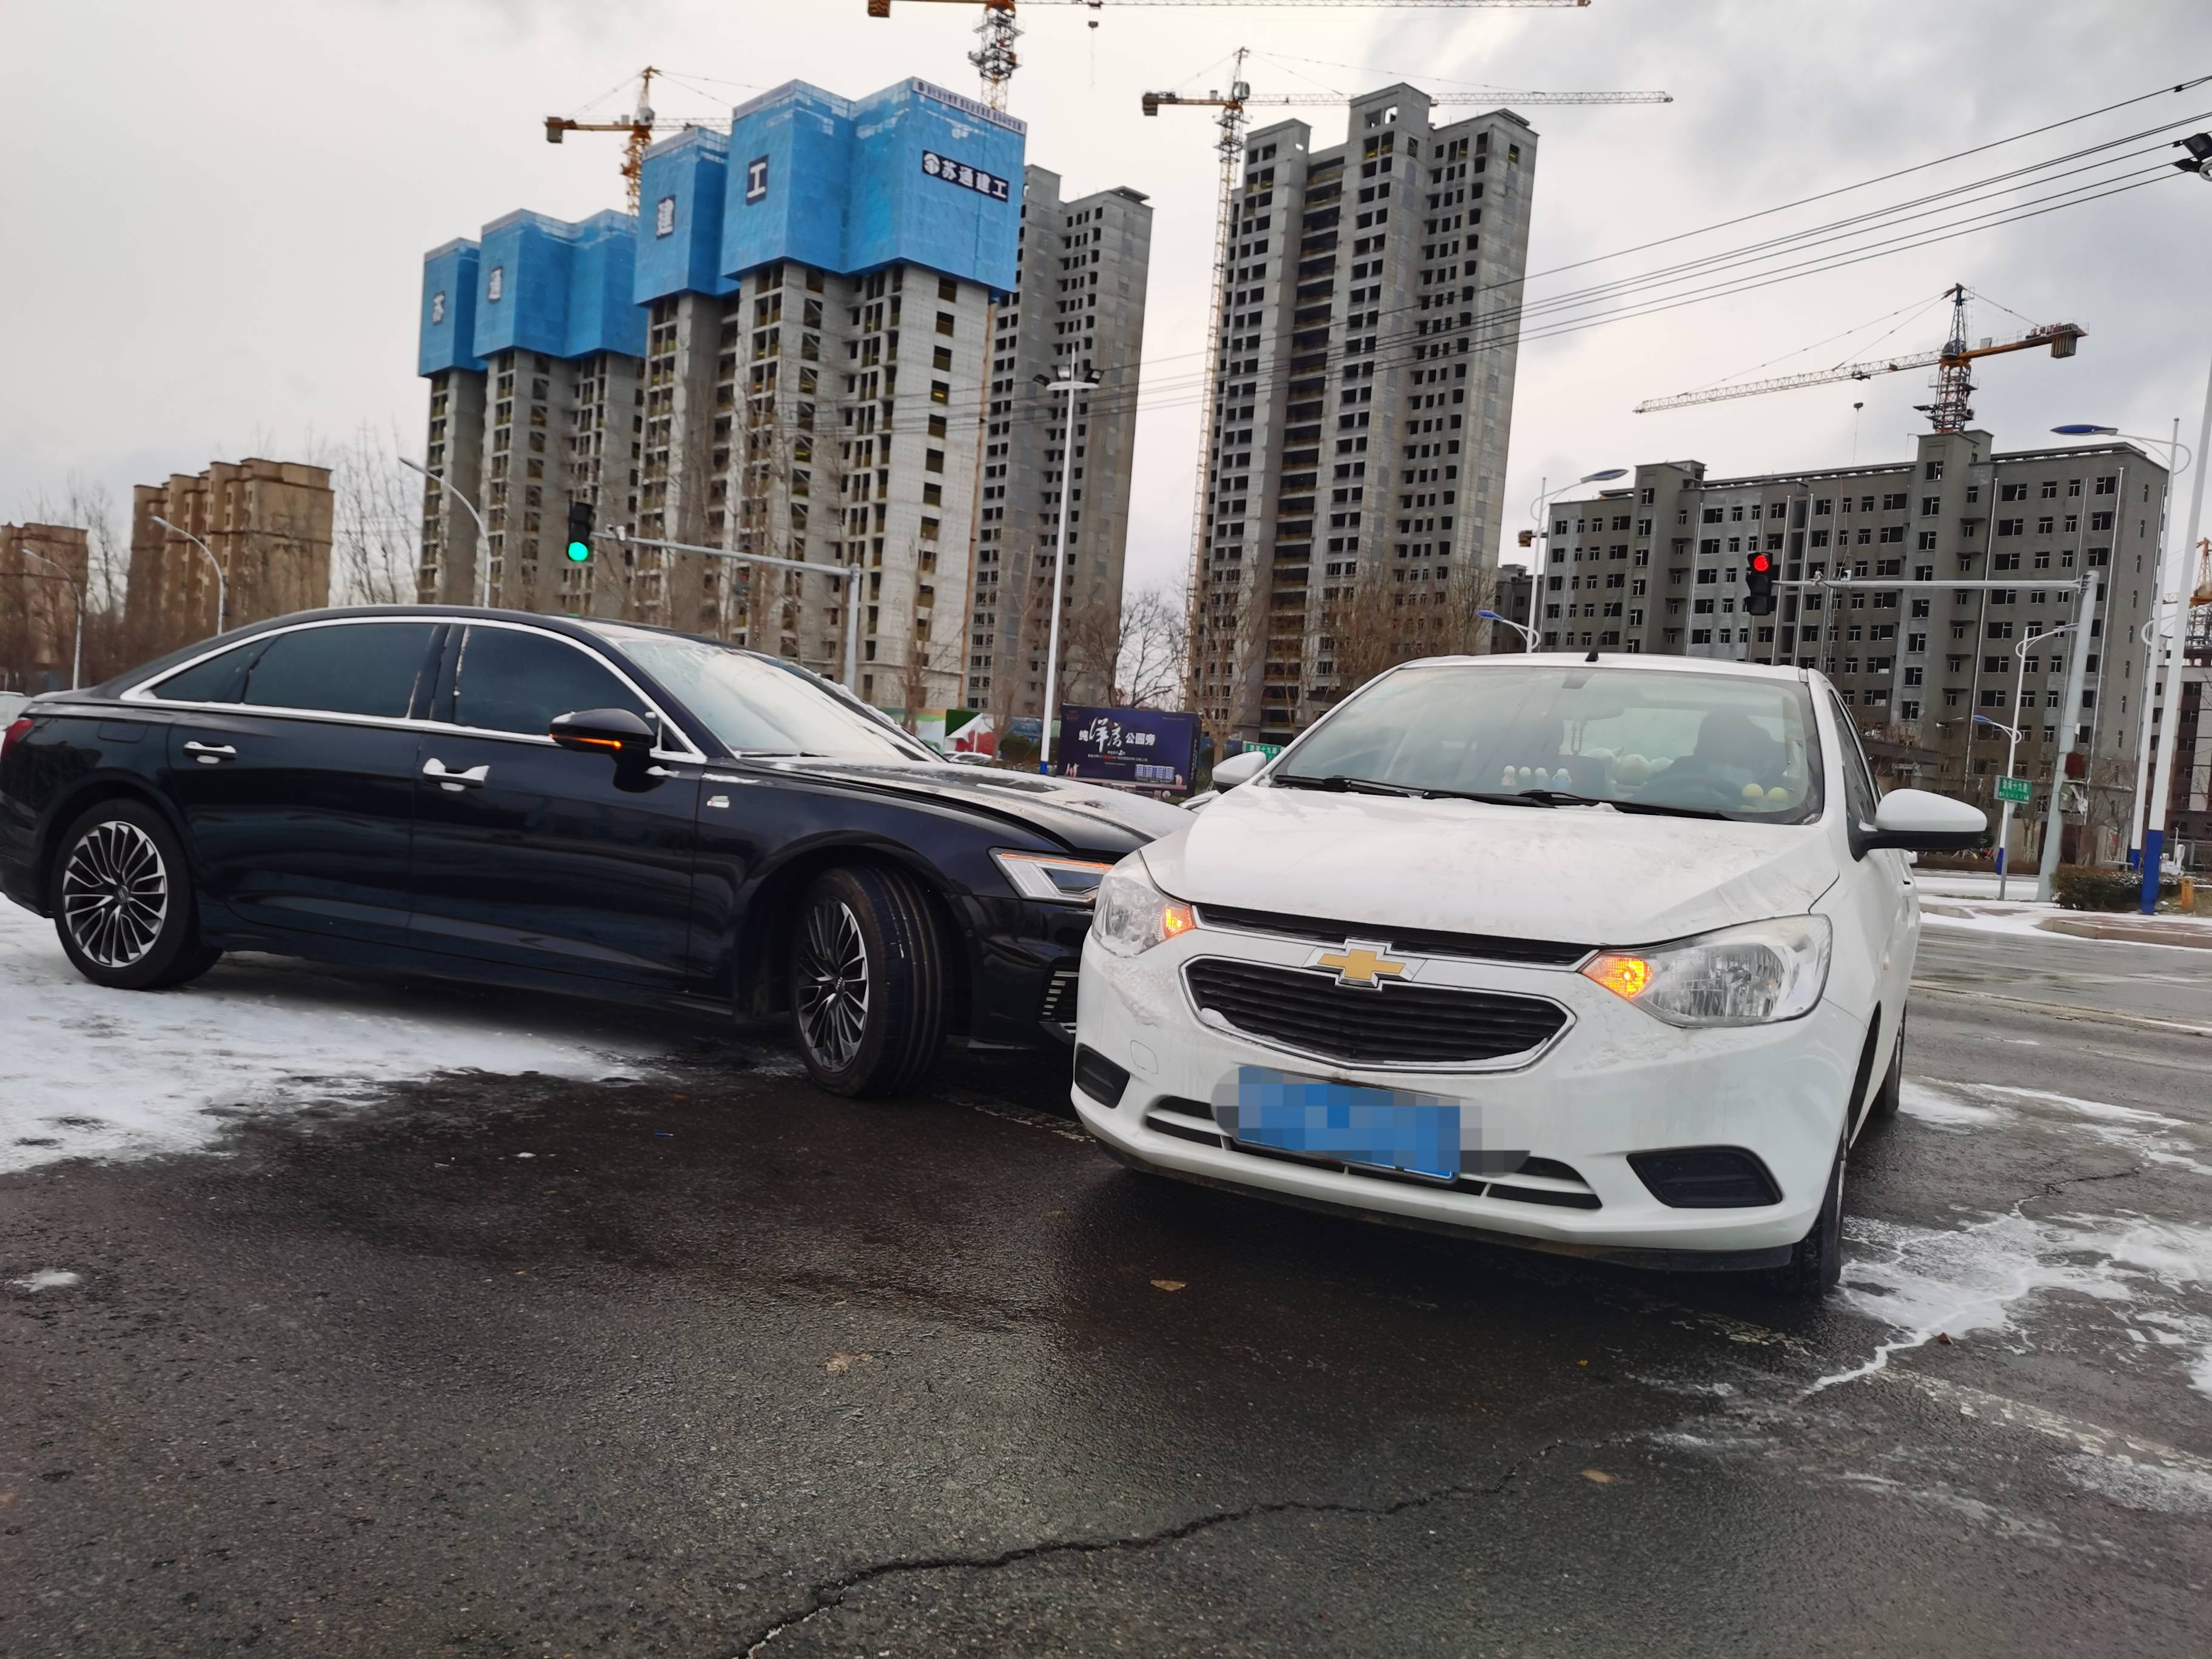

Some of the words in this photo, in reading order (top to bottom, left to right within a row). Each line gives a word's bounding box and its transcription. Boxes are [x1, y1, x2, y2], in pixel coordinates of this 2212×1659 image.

[746, 162, 766, 198] 工
[941, 160, 1007, 199] 苏通建工
